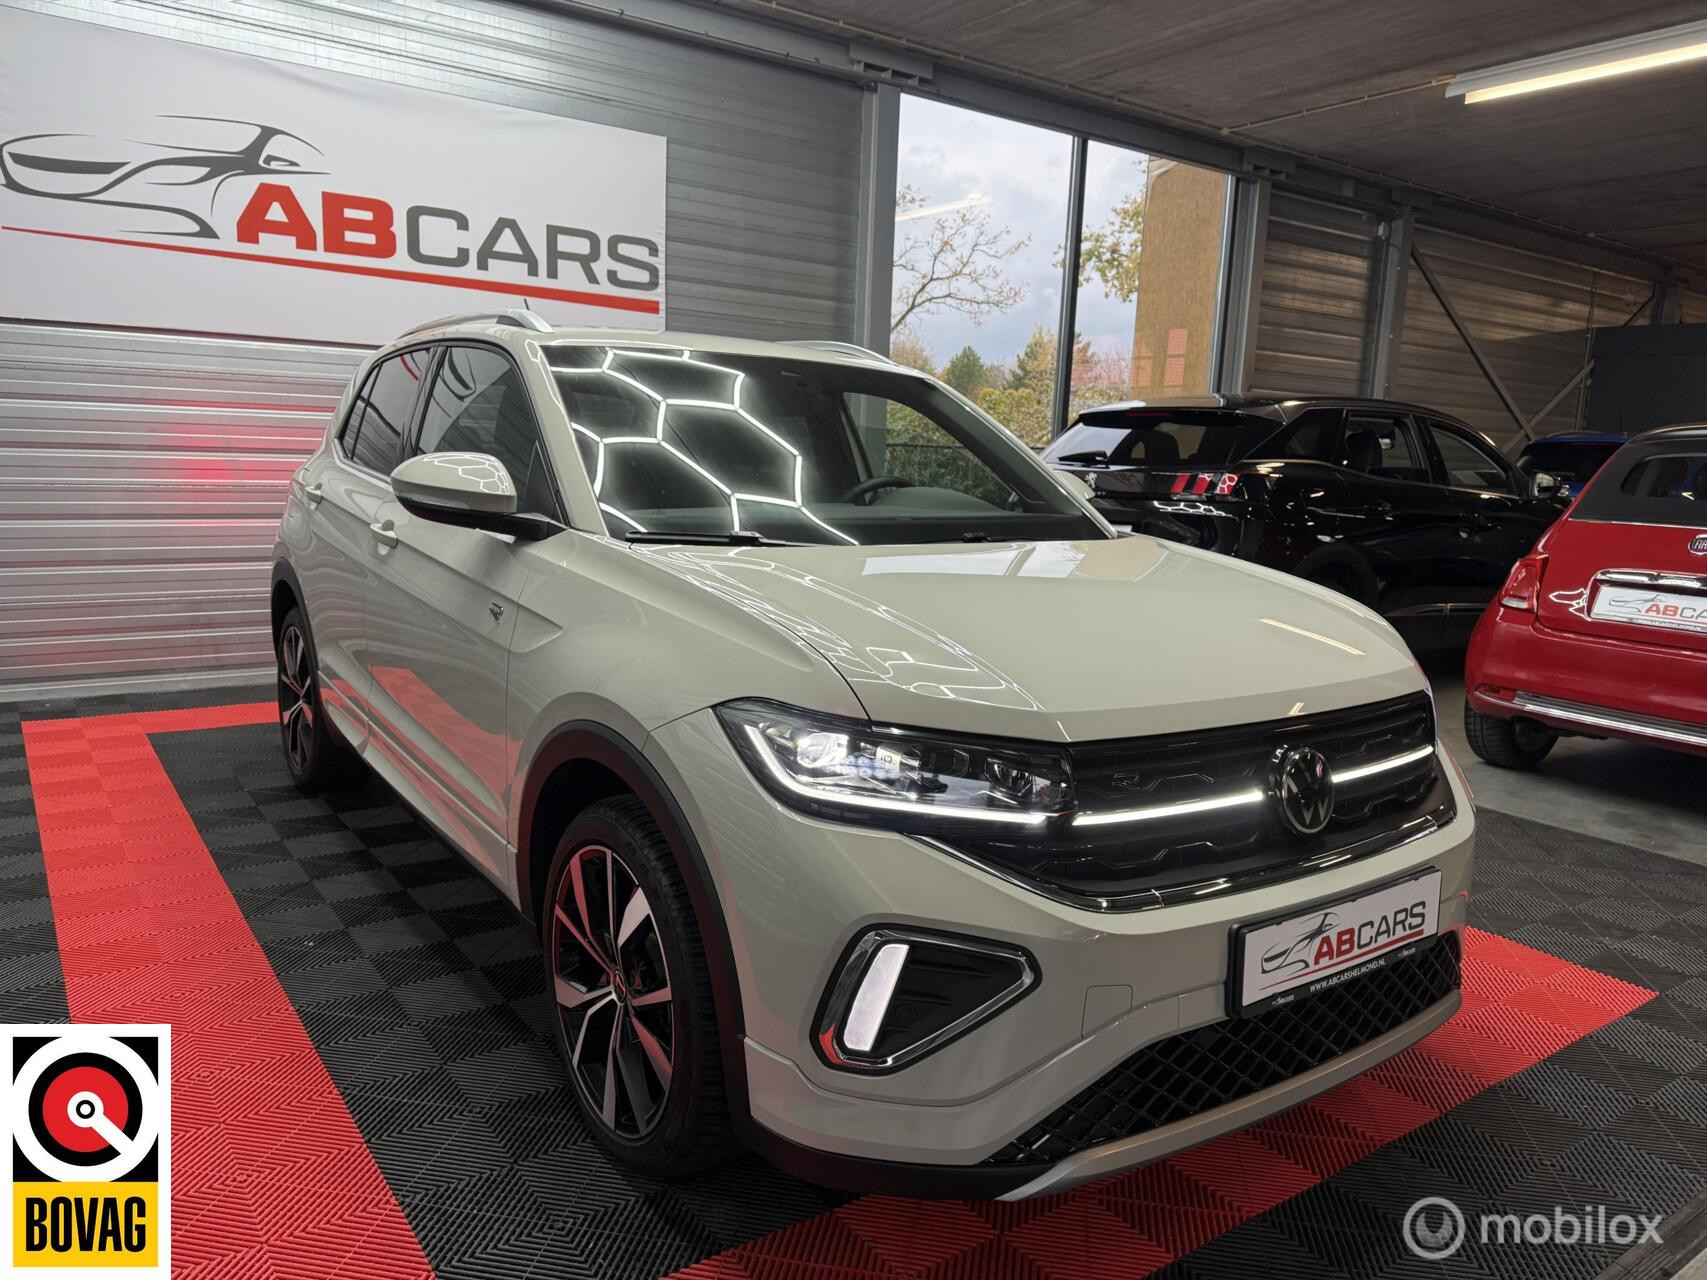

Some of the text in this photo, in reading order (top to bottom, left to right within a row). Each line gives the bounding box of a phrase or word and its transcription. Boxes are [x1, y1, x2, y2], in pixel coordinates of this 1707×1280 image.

[236, 182, 660, 292] ABCARS
[1313, 901, 1426, 966] ABCARS
[1309, 958, 1386, 993] WWW.ABCARSHELMOND.NL
